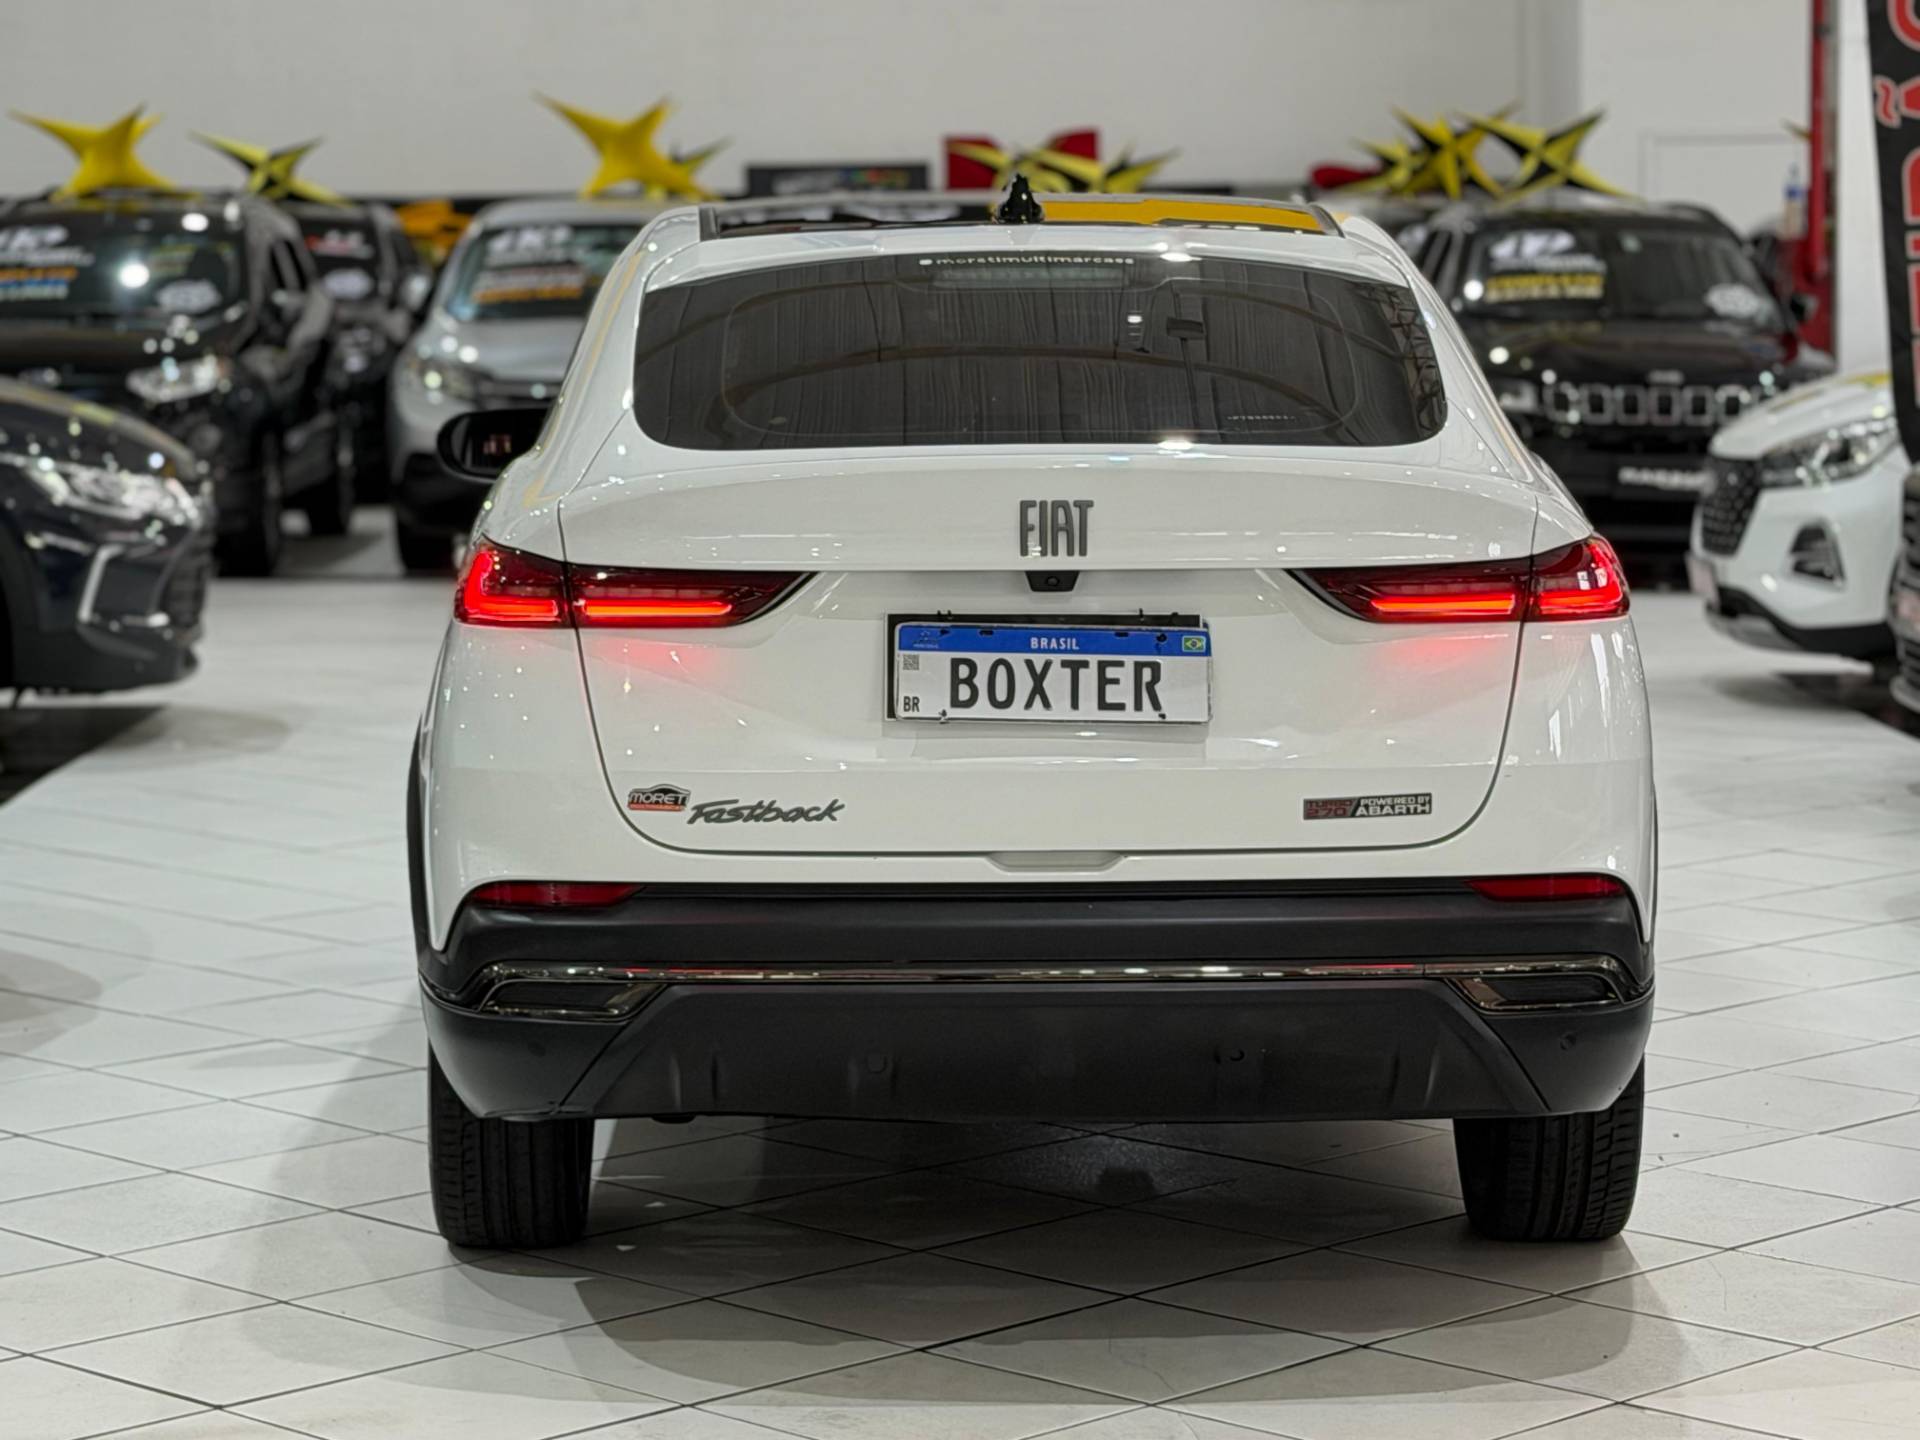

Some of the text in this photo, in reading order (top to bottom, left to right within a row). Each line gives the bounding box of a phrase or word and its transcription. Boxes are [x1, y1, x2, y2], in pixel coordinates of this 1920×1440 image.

[1020, 500, 1094, 557] FIAT
[1030, 637, 1080, 650] BRASIL
[950, 657, 1163, 712] BOXTER
[903, 696, 920, 712] BR
[1360, 797, 1415, 806] POWERED
[687, 799, 845, 824] Fastback
[1355, 804, 1430, 816] ABARTH
